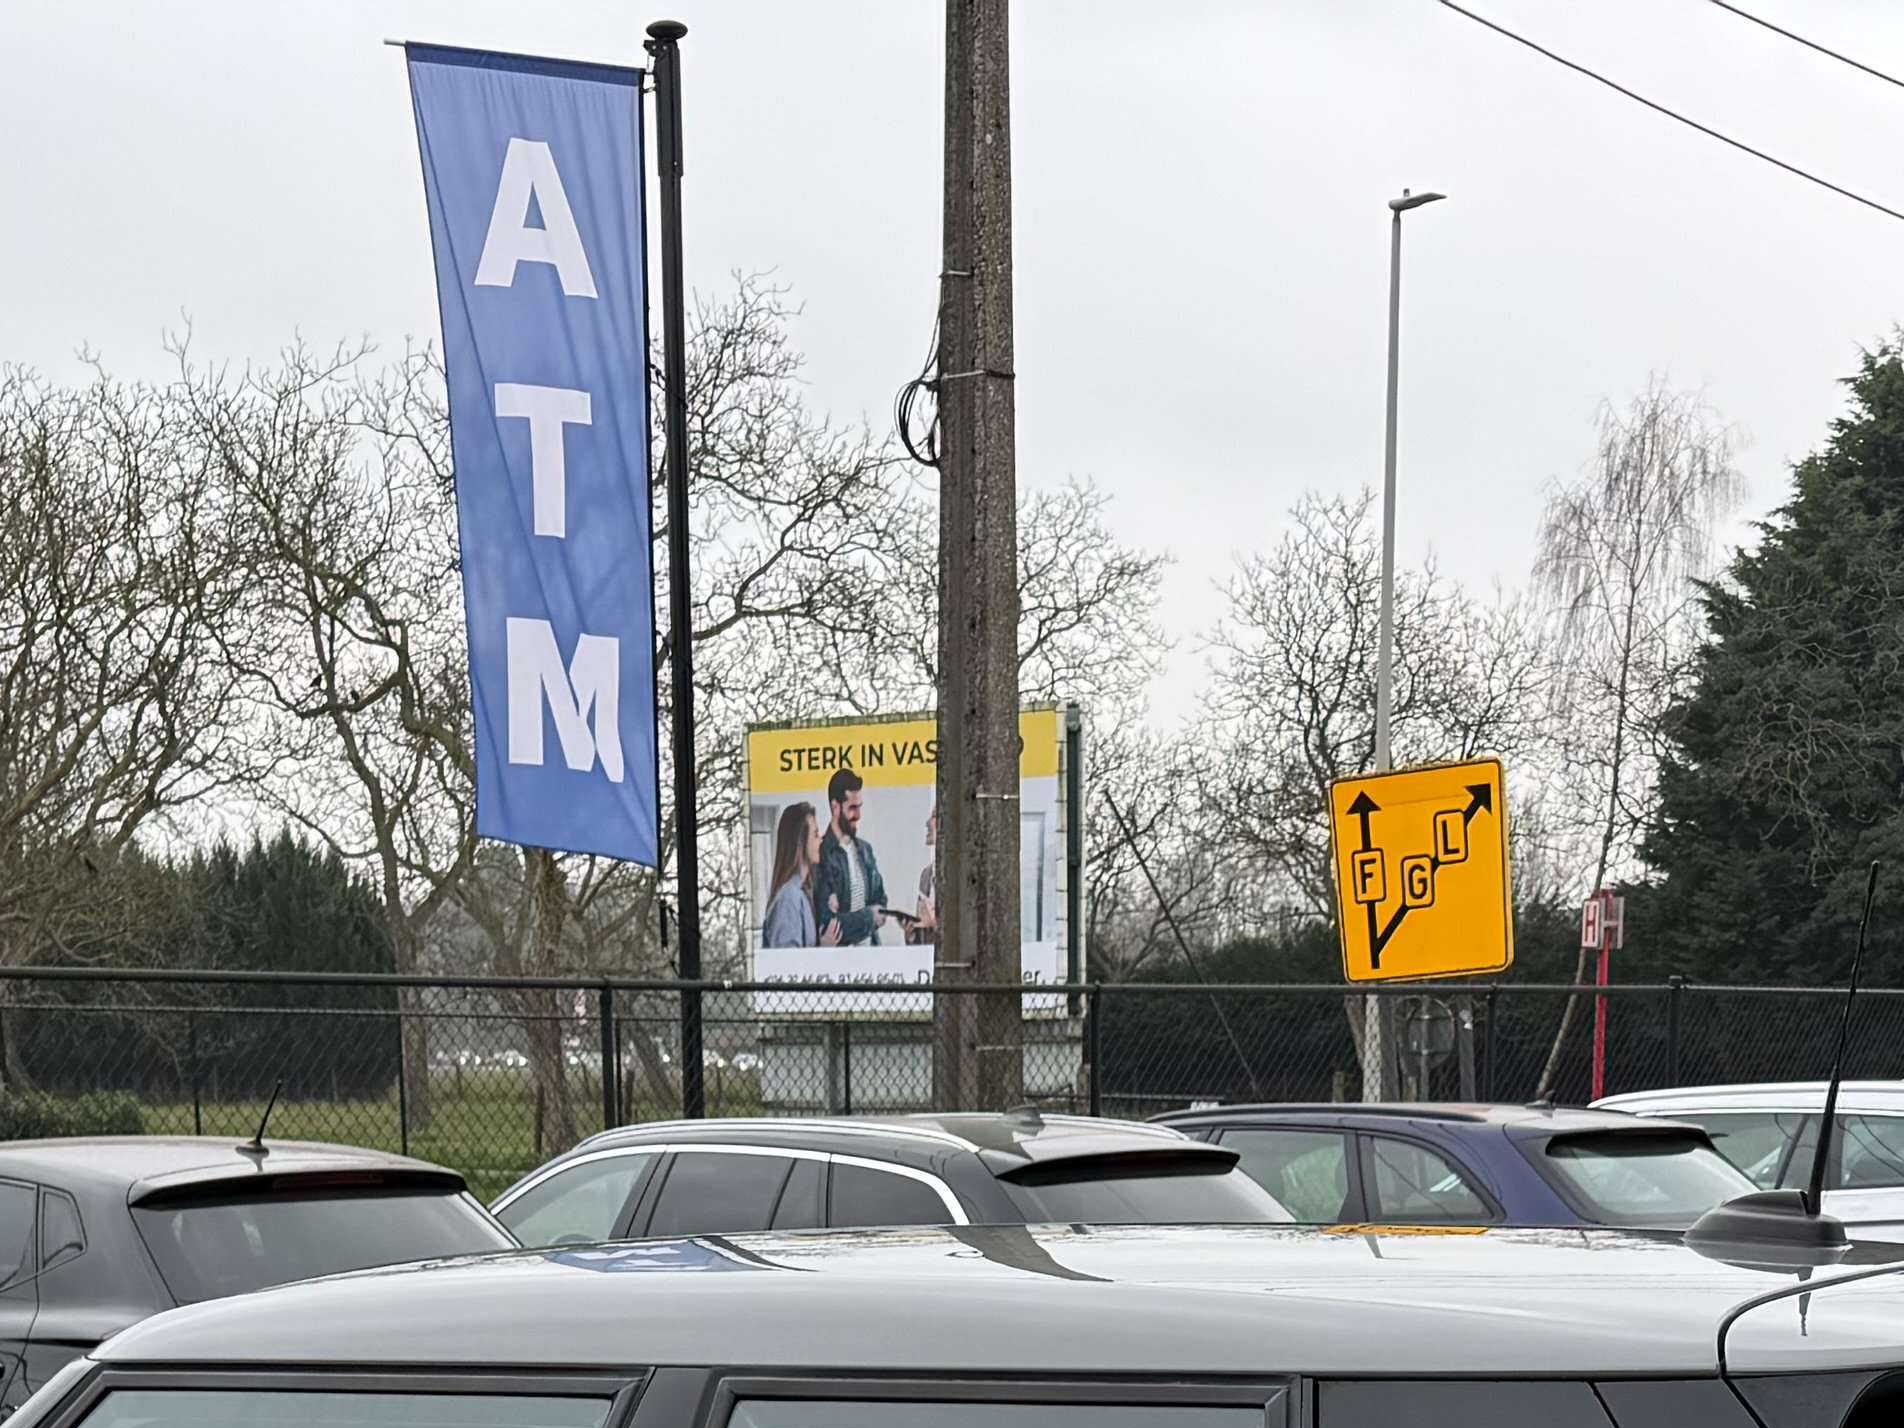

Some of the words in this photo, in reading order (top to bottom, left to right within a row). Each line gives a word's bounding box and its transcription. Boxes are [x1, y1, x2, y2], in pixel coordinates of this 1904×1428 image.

[474, 138, 621, 782] ATM
[779, 745, 854, 772] STERK
[860, 743, 884, 768] IN
[1441, 819, 1460, 855] L
[1357, 858, 1377, 895] F
[1408, 863, 1428, 899] G
